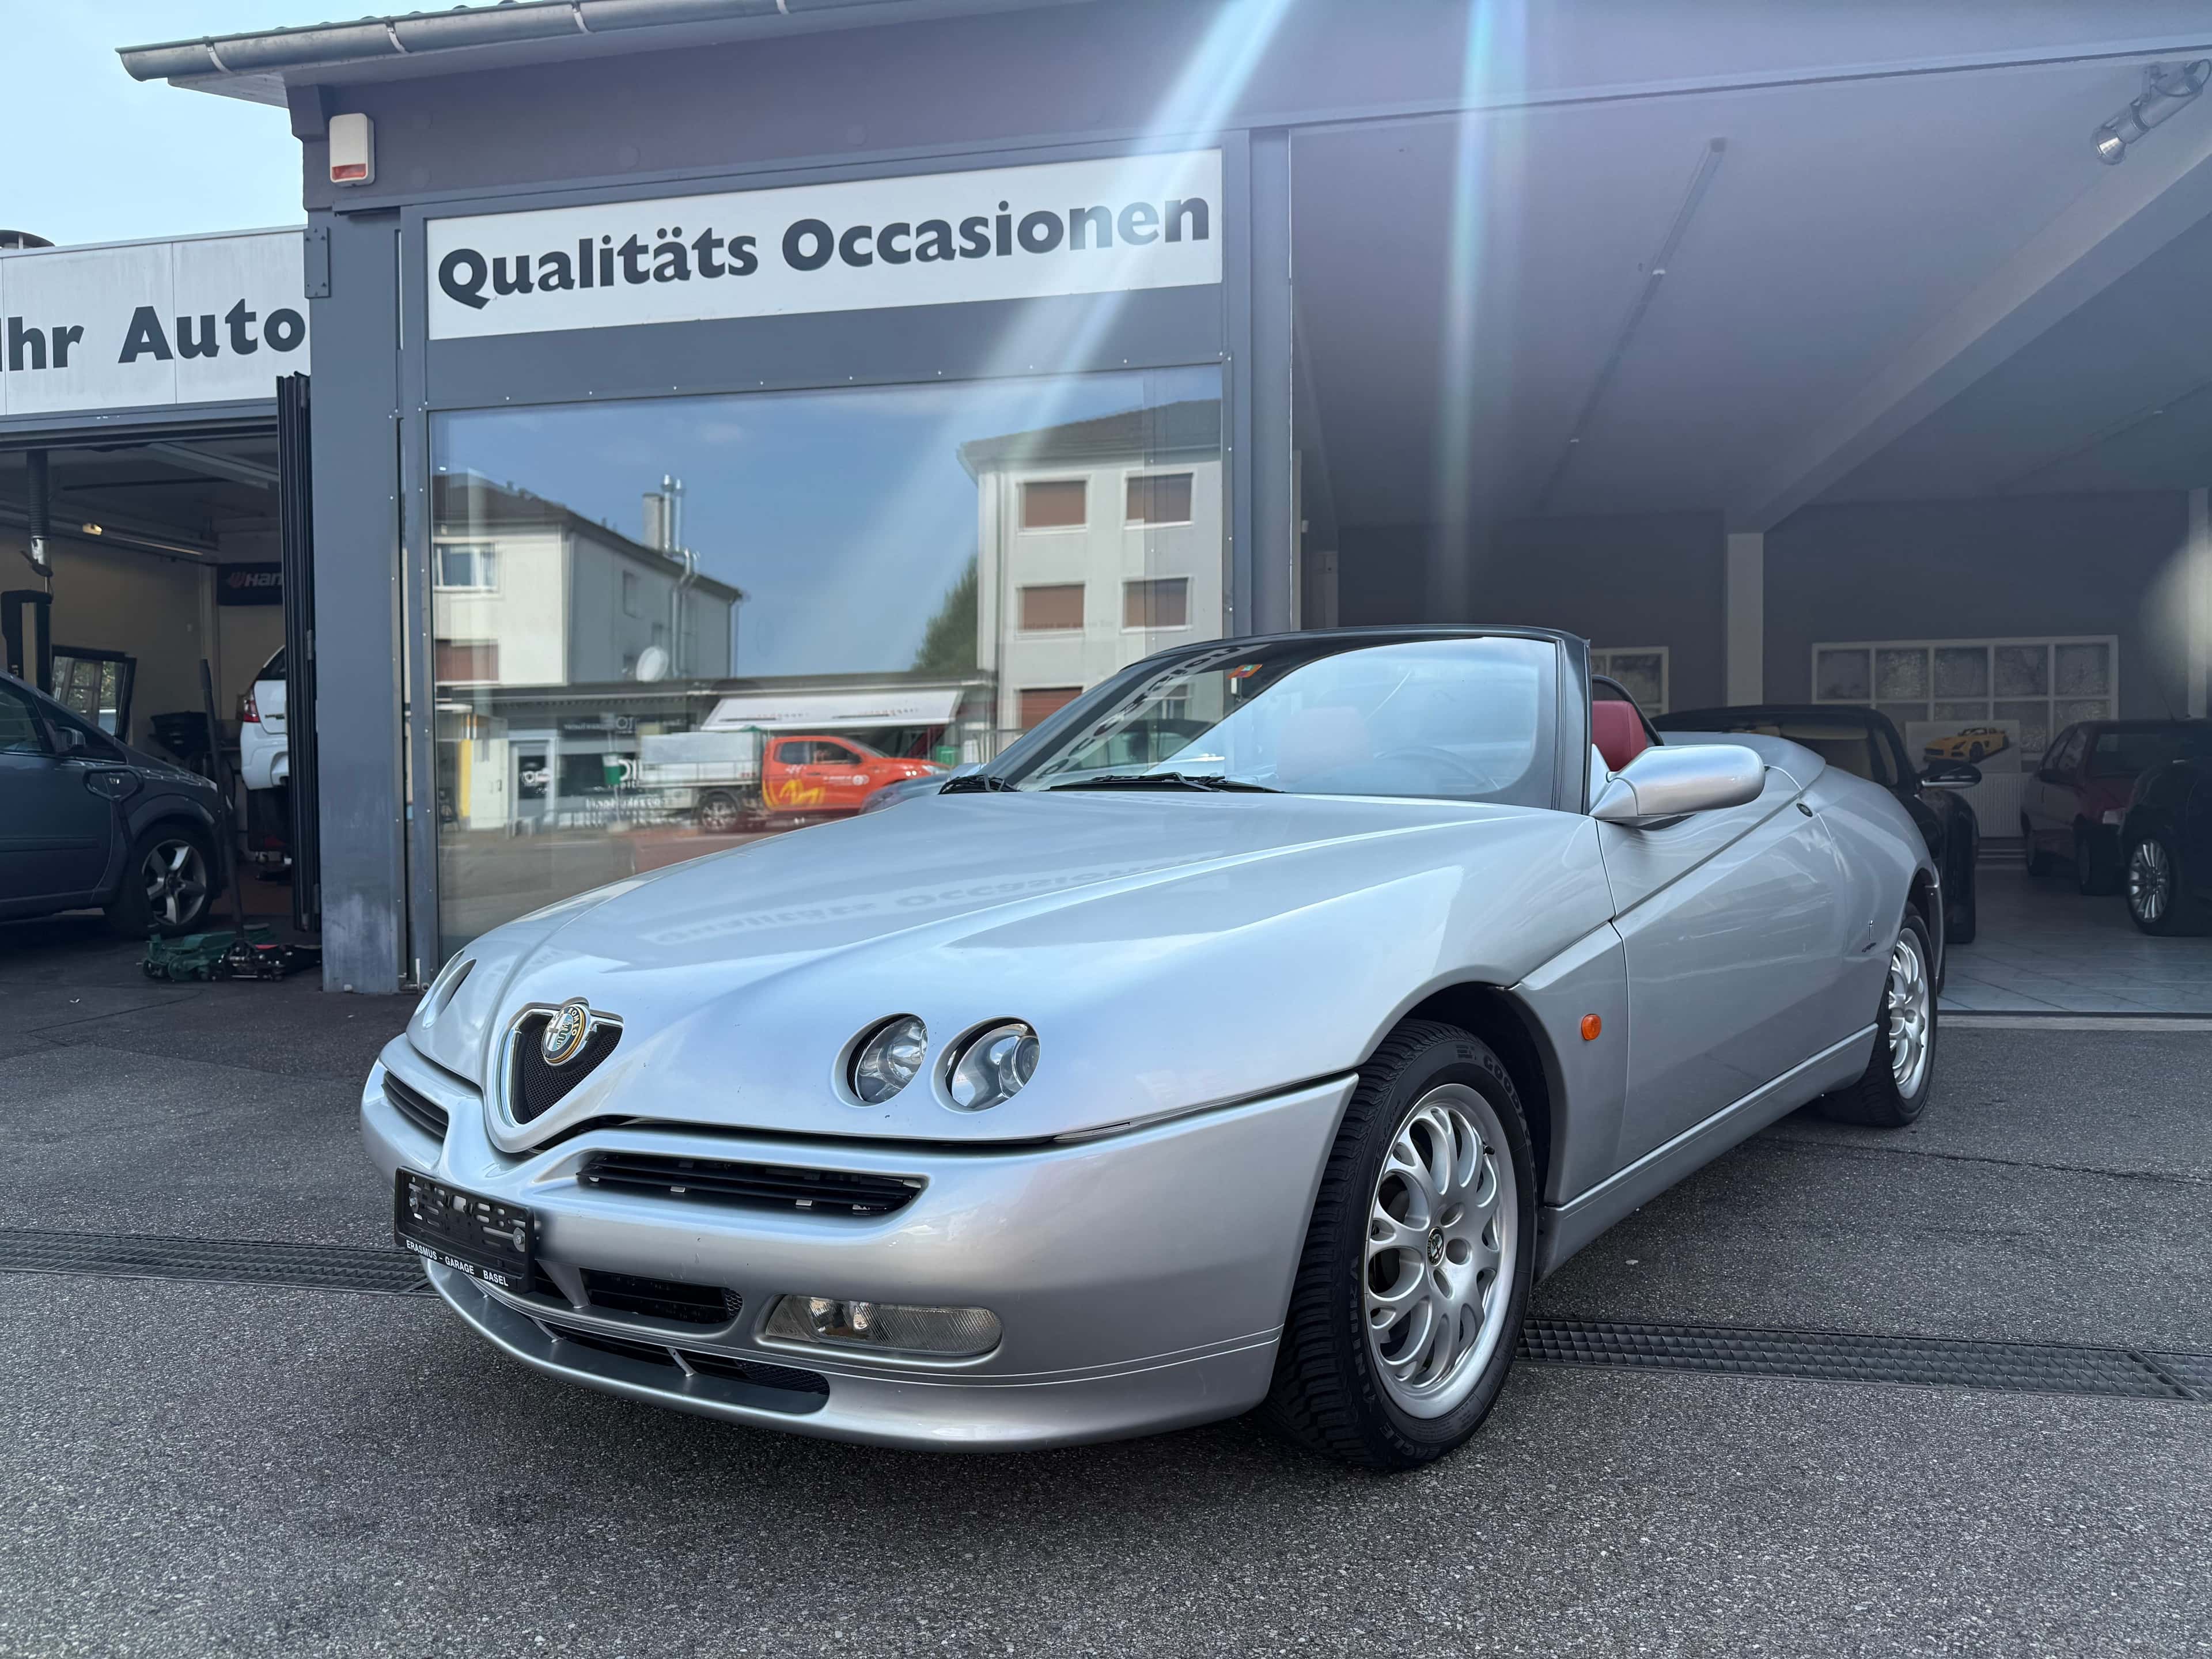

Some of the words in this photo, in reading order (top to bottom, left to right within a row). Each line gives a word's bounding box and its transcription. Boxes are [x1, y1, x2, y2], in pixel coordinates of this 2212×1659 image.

[438, 226, 758, 309] Qualitäts
[782, 198, 1209, 271] Occasionen
[0, 316, 84, 372] hr
[118, 298, 305, 363] Auto
[567, 1007, 580, 1036] ROMEO
[406, 1239, 437, 1260] ERASMUS
[445, 1256, 475, 1275] GARAGE
[483, 1270, 509, 1287] BASEL
[1379, 1422, 1441, 1459] EAGLE
